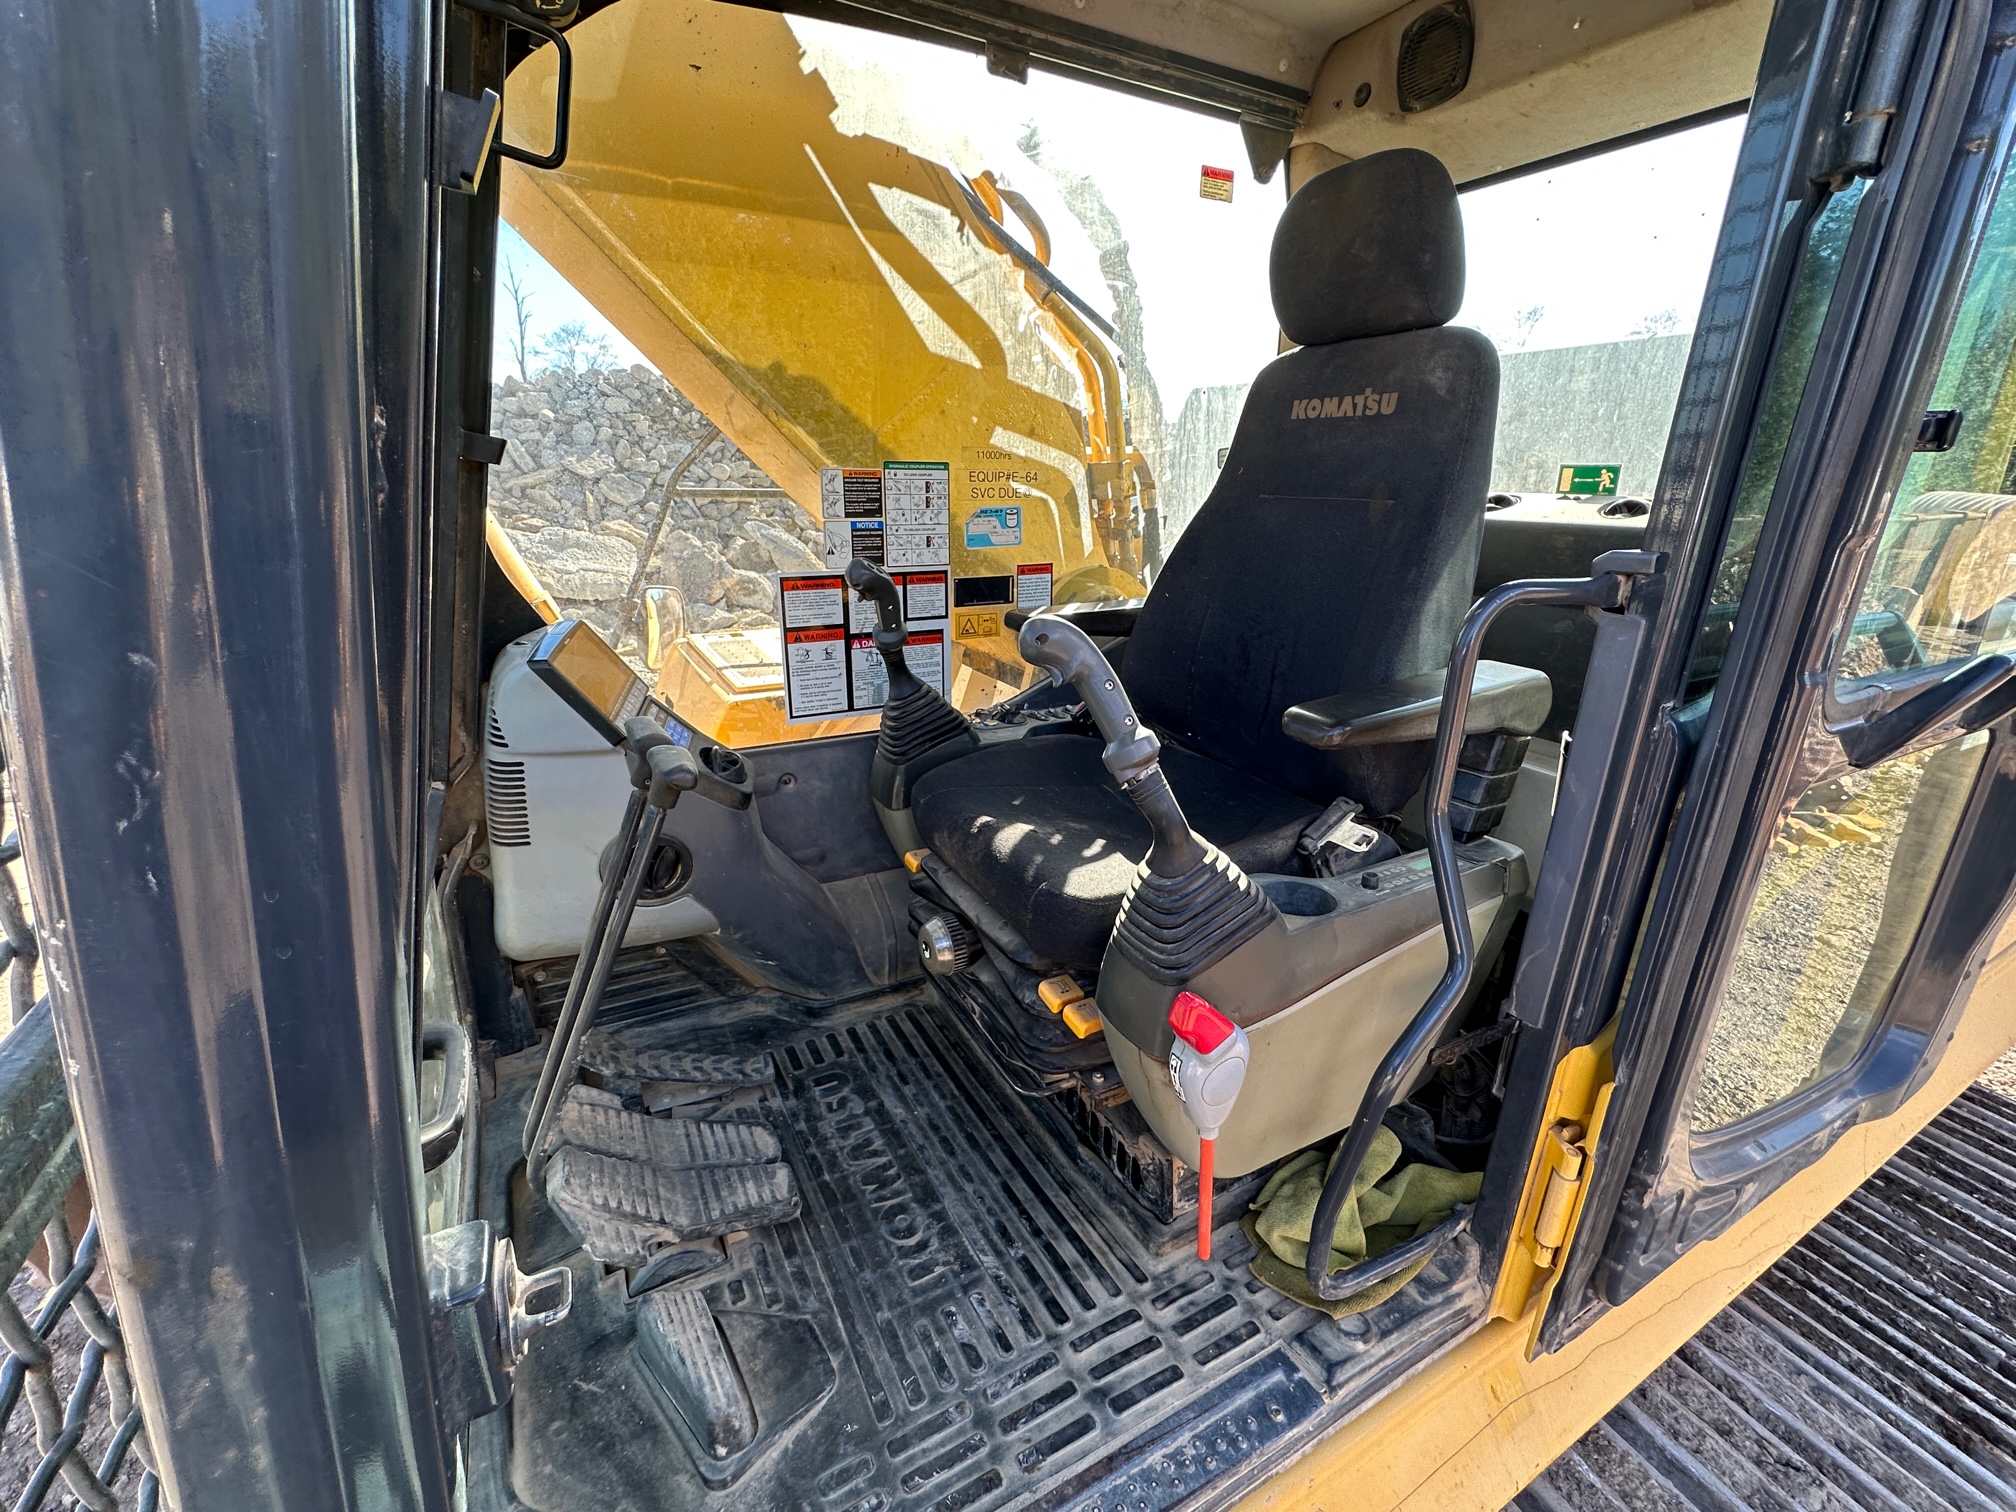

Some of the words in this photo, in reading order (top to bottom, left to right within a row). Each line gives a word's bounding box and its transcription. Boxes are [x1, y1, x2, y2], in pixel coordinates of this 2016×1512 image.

[1290, 387, 1399, 420] KOMATSU
[976, 450, 1012, 460] 11000hrs
[969, 470, 1038, 483] EQUIP#E-64
[971, 487, 995, 499] SVC
[856, 521, 879, 529] NOTICE
[803, 631, 839, 641] WARNING
